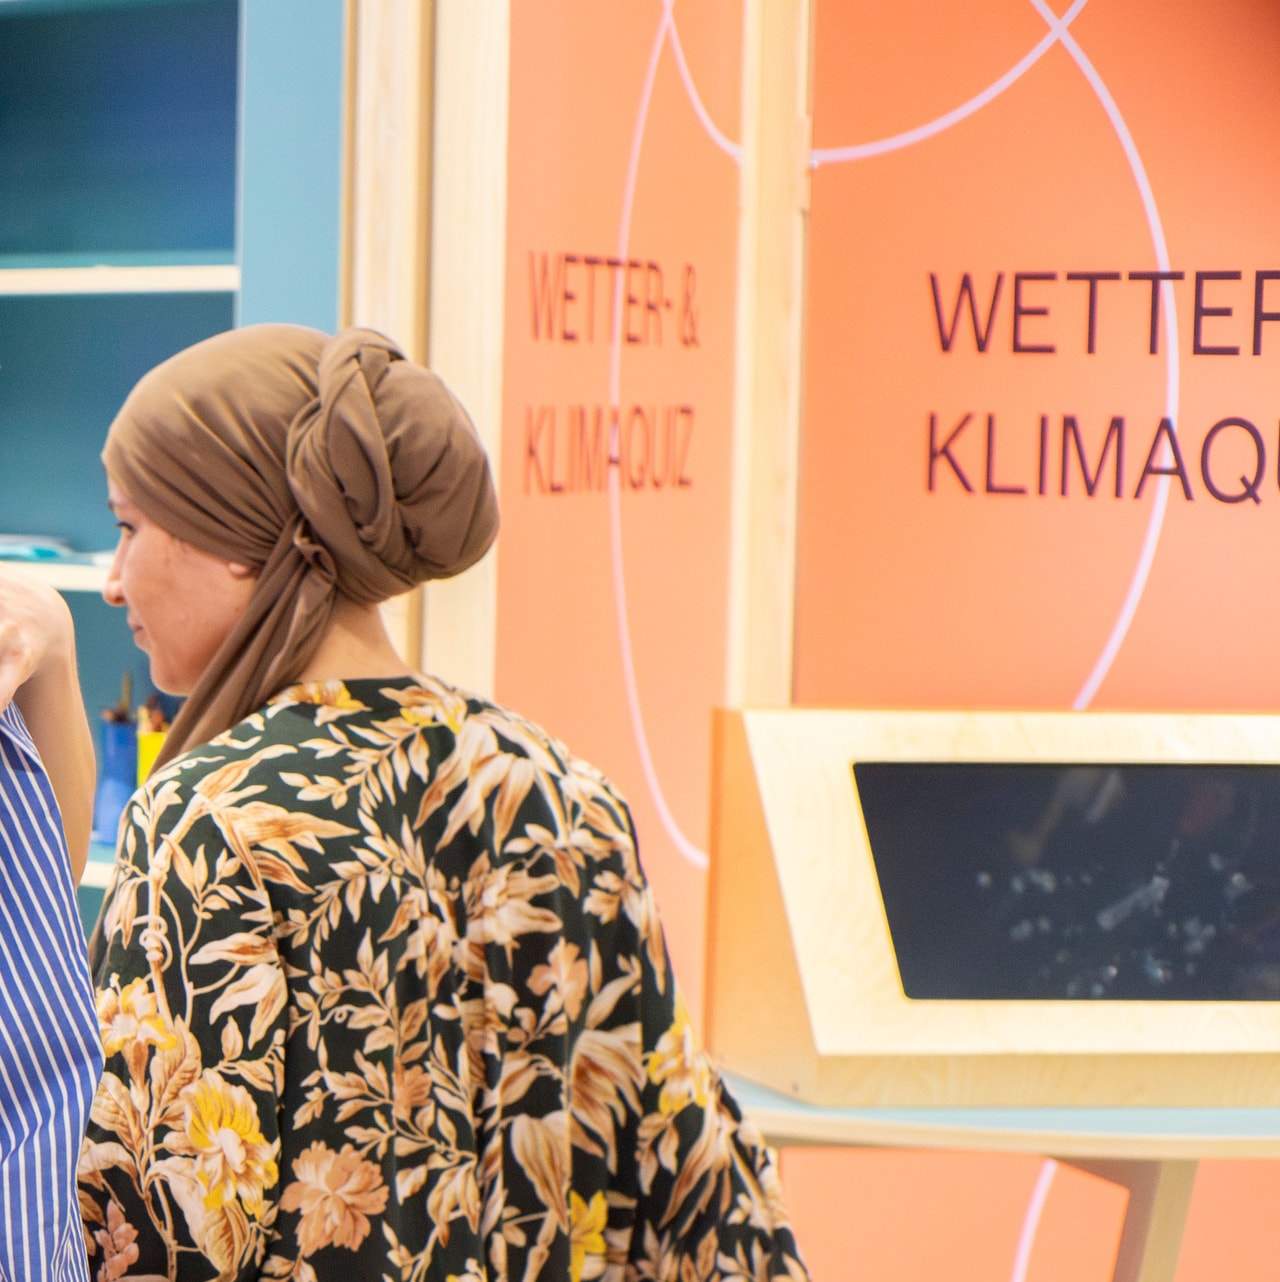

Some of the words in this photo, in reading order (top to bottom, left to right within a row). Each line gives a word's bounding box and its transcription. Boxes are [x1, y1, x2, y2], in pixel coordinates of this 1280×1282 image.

[528, 250, 673, 347] WETTER-
[681, 262, 701, 349] &
[524, 404, 695, 496] KLIMAQUIZ
[926, 411, 1280, 506] KLIMAQ
